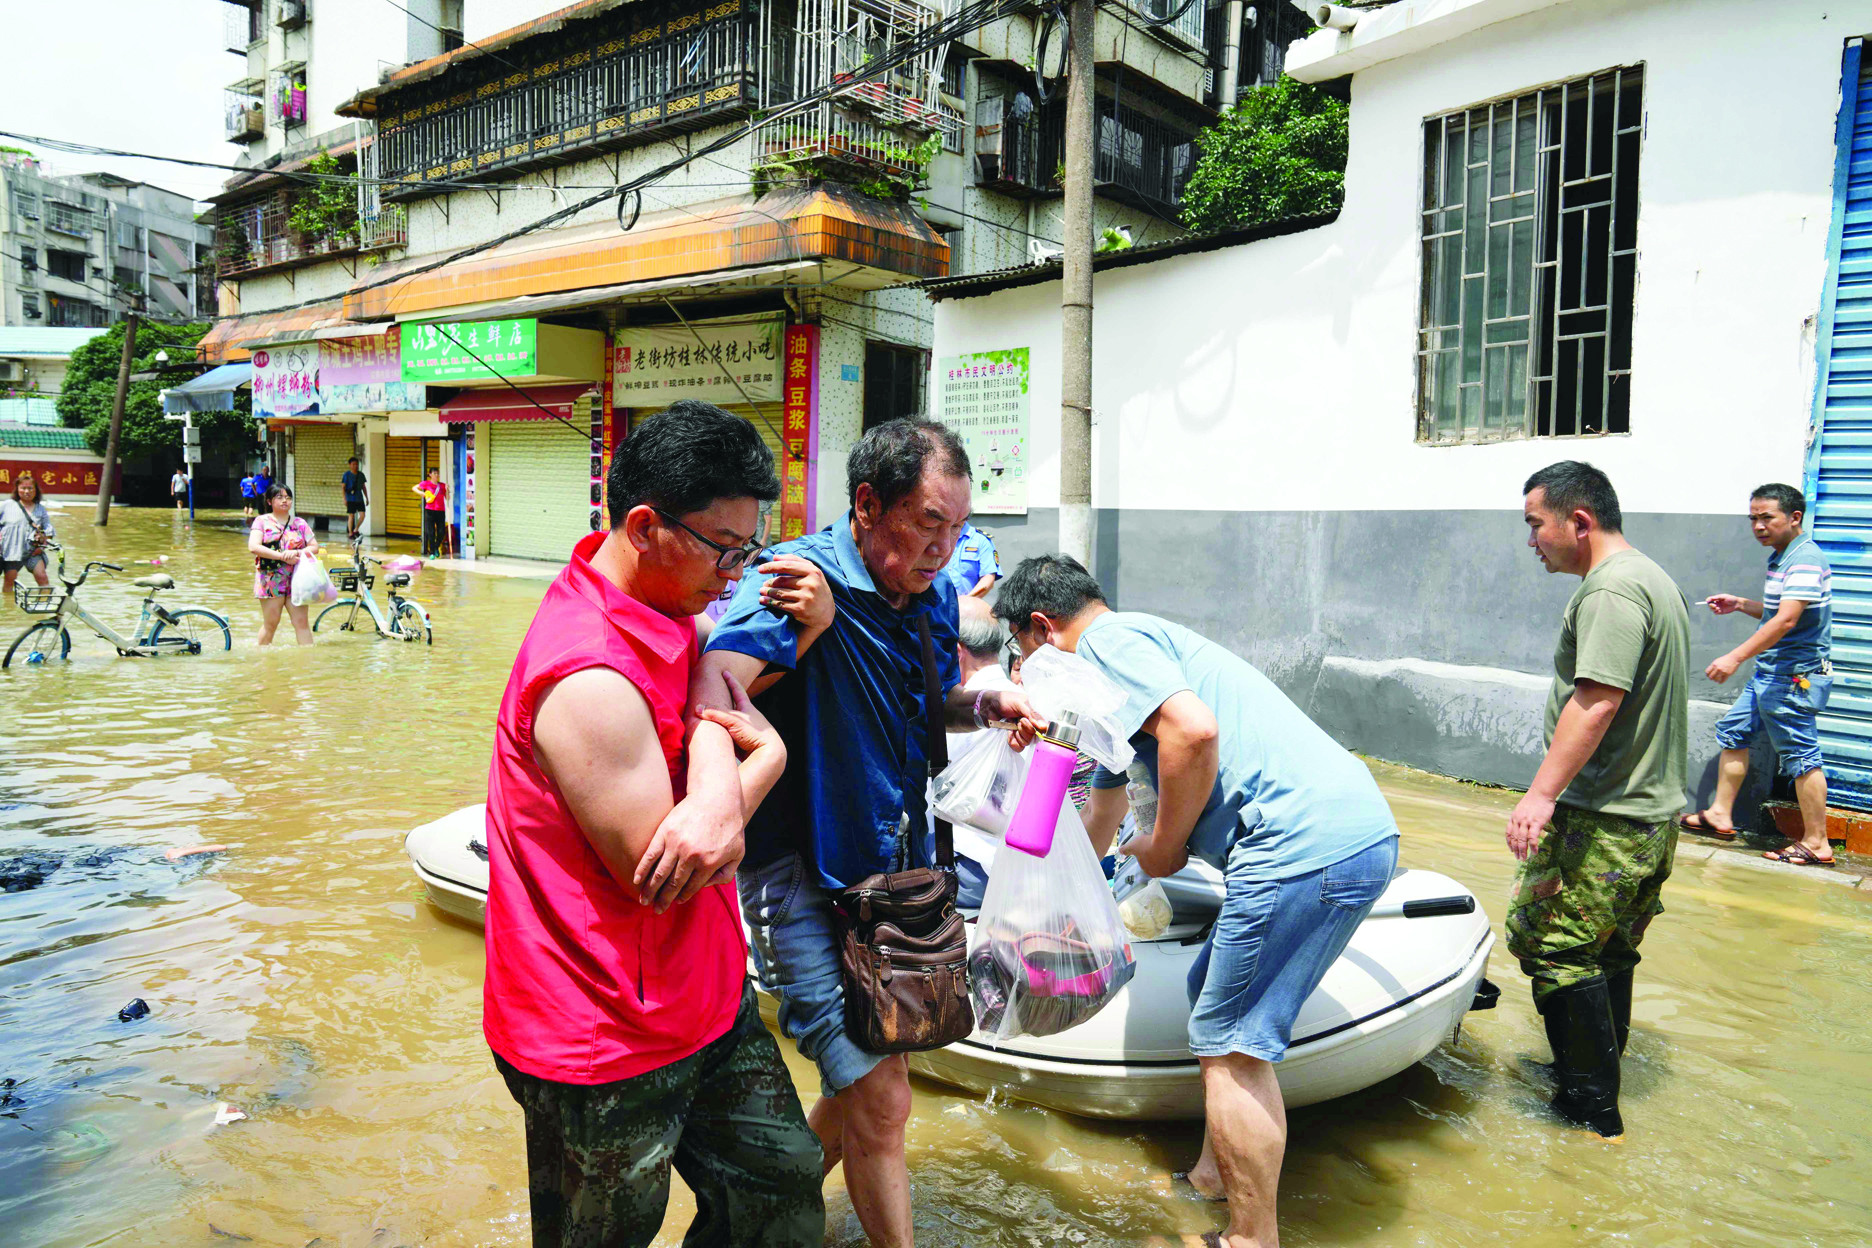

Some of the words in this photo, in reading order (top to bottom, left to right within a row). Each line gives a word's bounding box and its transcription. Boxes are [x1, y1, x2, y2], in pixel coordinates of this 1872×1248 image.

[634, 337, 775, 371] 老街坊桂林传统小吃
[789, 335, 807, 379] 油条
[948, 363, 1013, 381] 桂林市民文明公约
[788, 387, 806, 430] 豆浆
[786, 438, 804, 505] 豆腐脑
